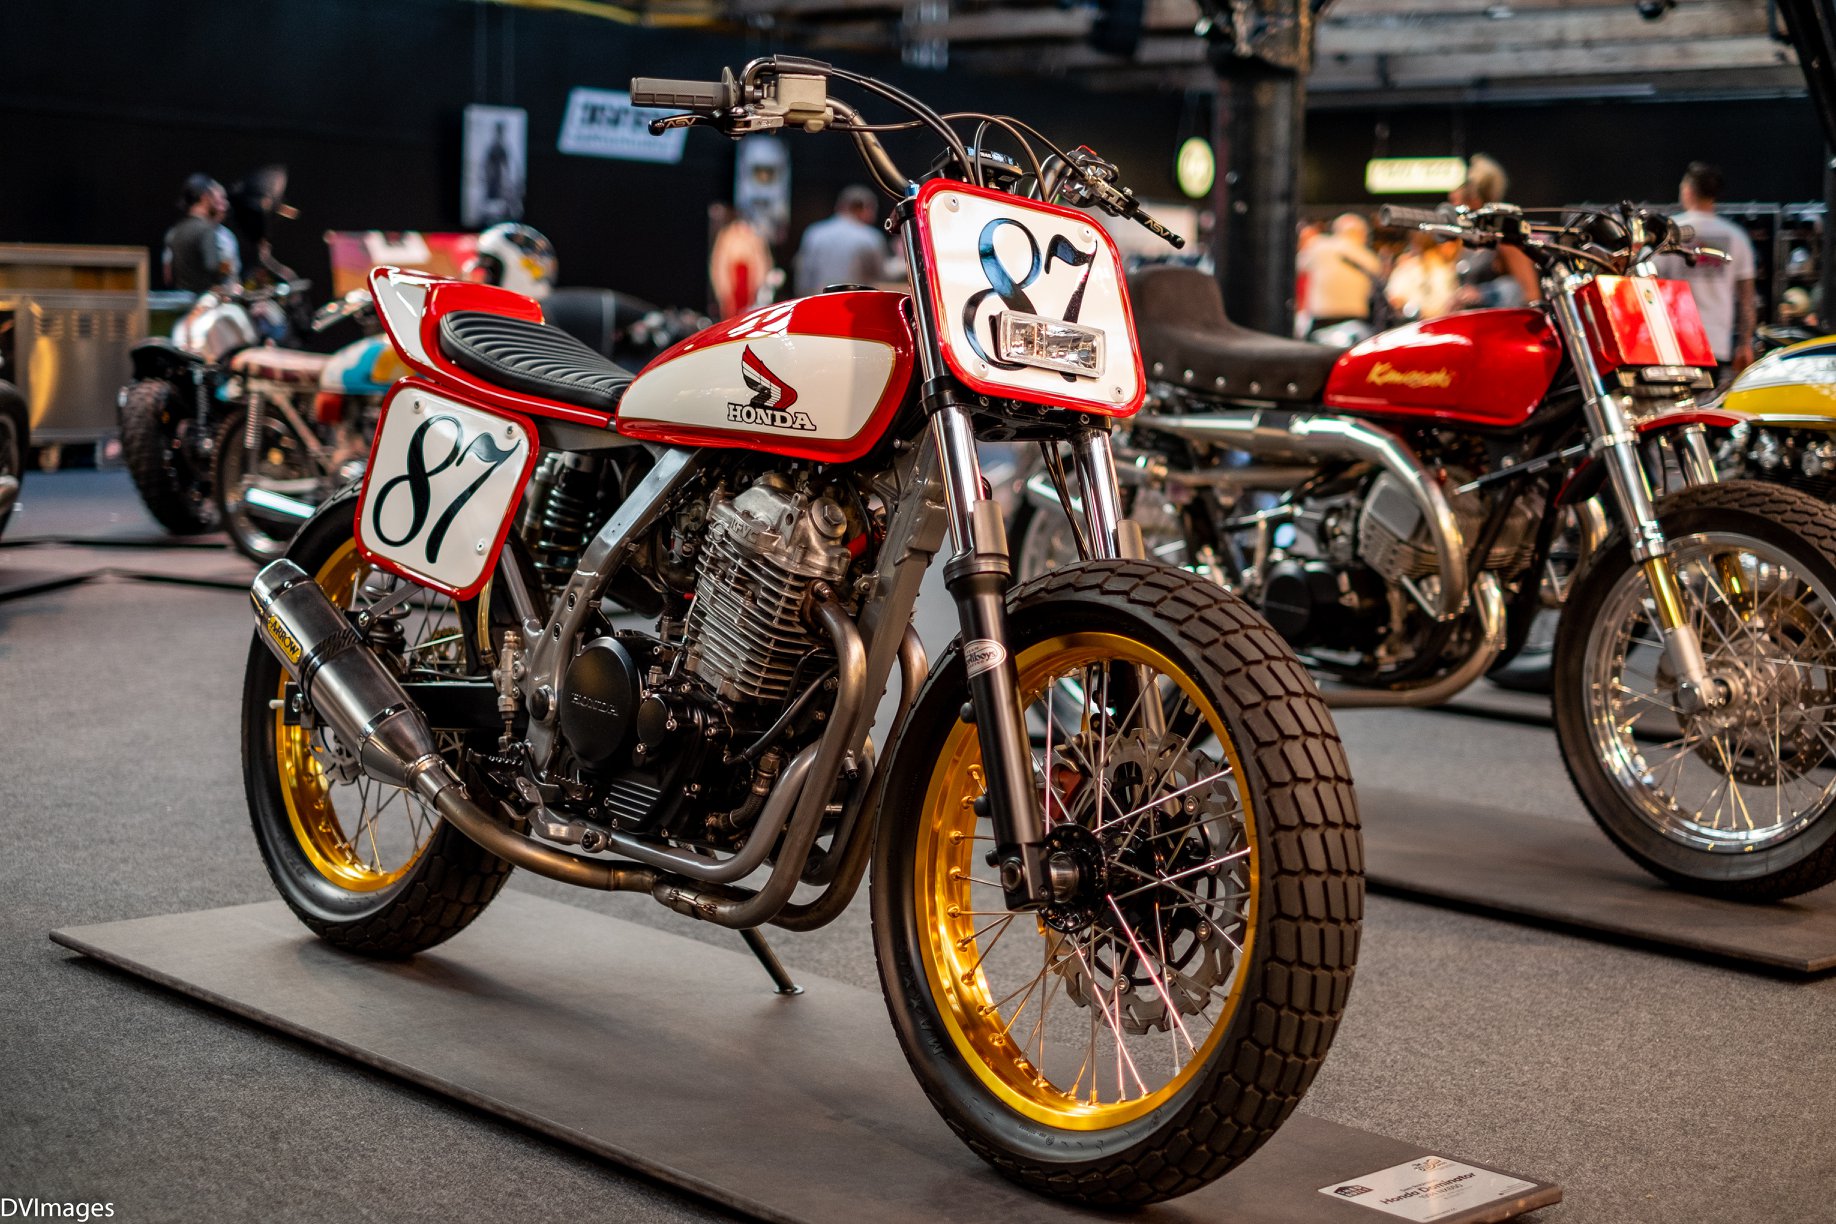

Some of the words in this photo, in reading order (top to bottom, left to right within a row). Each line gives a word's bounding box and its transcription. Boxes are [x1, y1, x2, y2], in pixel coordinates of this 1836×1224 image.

[666, 118, 696, 128] ASV
[1144, 219, 1170, 237] ASV
[962, 217, 1098, 382] 87
[727, 402, 817, 431] HONDA
[373, 414, 522, 564] 87
[270, 620, 299, 655] ARROW
[571, 692, 619, 716] HONDA
[1380, 1191, 1420, 1205] Honda
